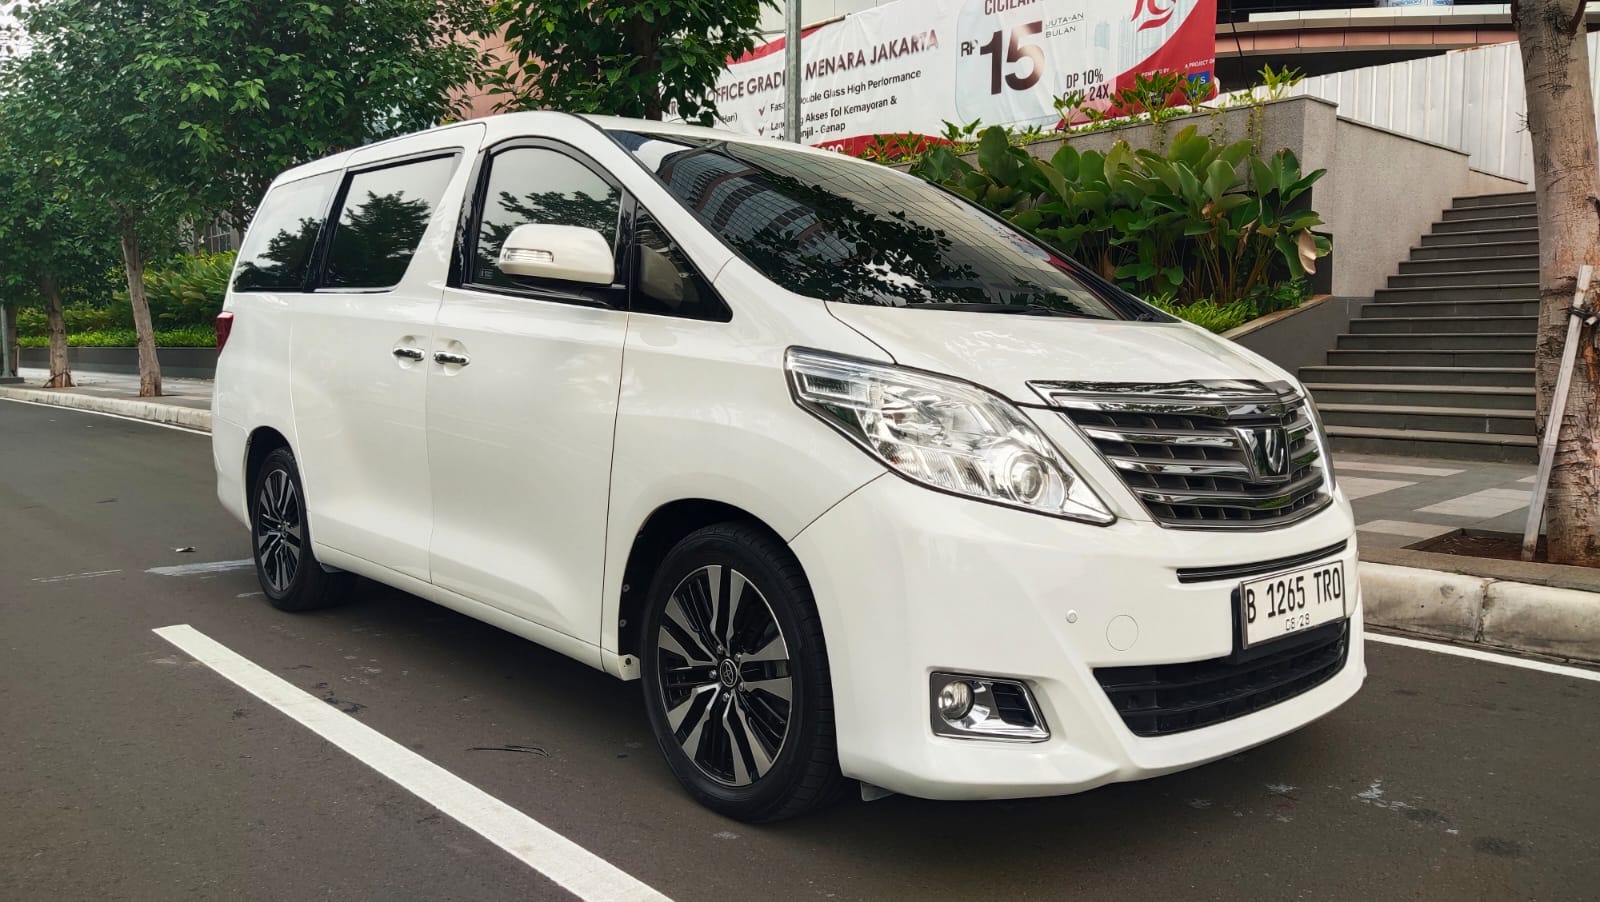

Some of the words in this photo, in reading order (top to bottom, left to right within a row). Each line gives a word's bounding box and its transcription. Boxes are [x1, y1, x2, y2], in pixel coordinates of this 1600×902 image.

[984, 0, 1035, 15] CICIL
[1045, 25, 1076, 38] BULAN
[805, 49, 866, 80] MENARA
[870, 29, 939, 65] JAKARTA
[980, 20, 1045, 95] 15
[800, 92, 822, 104] ouble
[823, 88, 846, 99] Glass
[847, 81, 866, 95] High
[867, 70, 921, 90] Performance
[1066, 73, 1079, 89] DP
[1082, 68, 1104, 86] 10%
[1089, 83, 1109, 101] 24X
[805, 111, 829, 123] Akses
[830, 106, 842, 118] Tol
[843, 99, 889, 116] Kemayoran
[890, 95, 898, 105] &
[820, 123, 846, 134] Genap
[1246, 588, 1257, 623] B
[1266, 576, 1306, 618] 1265
[1313, 567, 1341, 604] TRO
